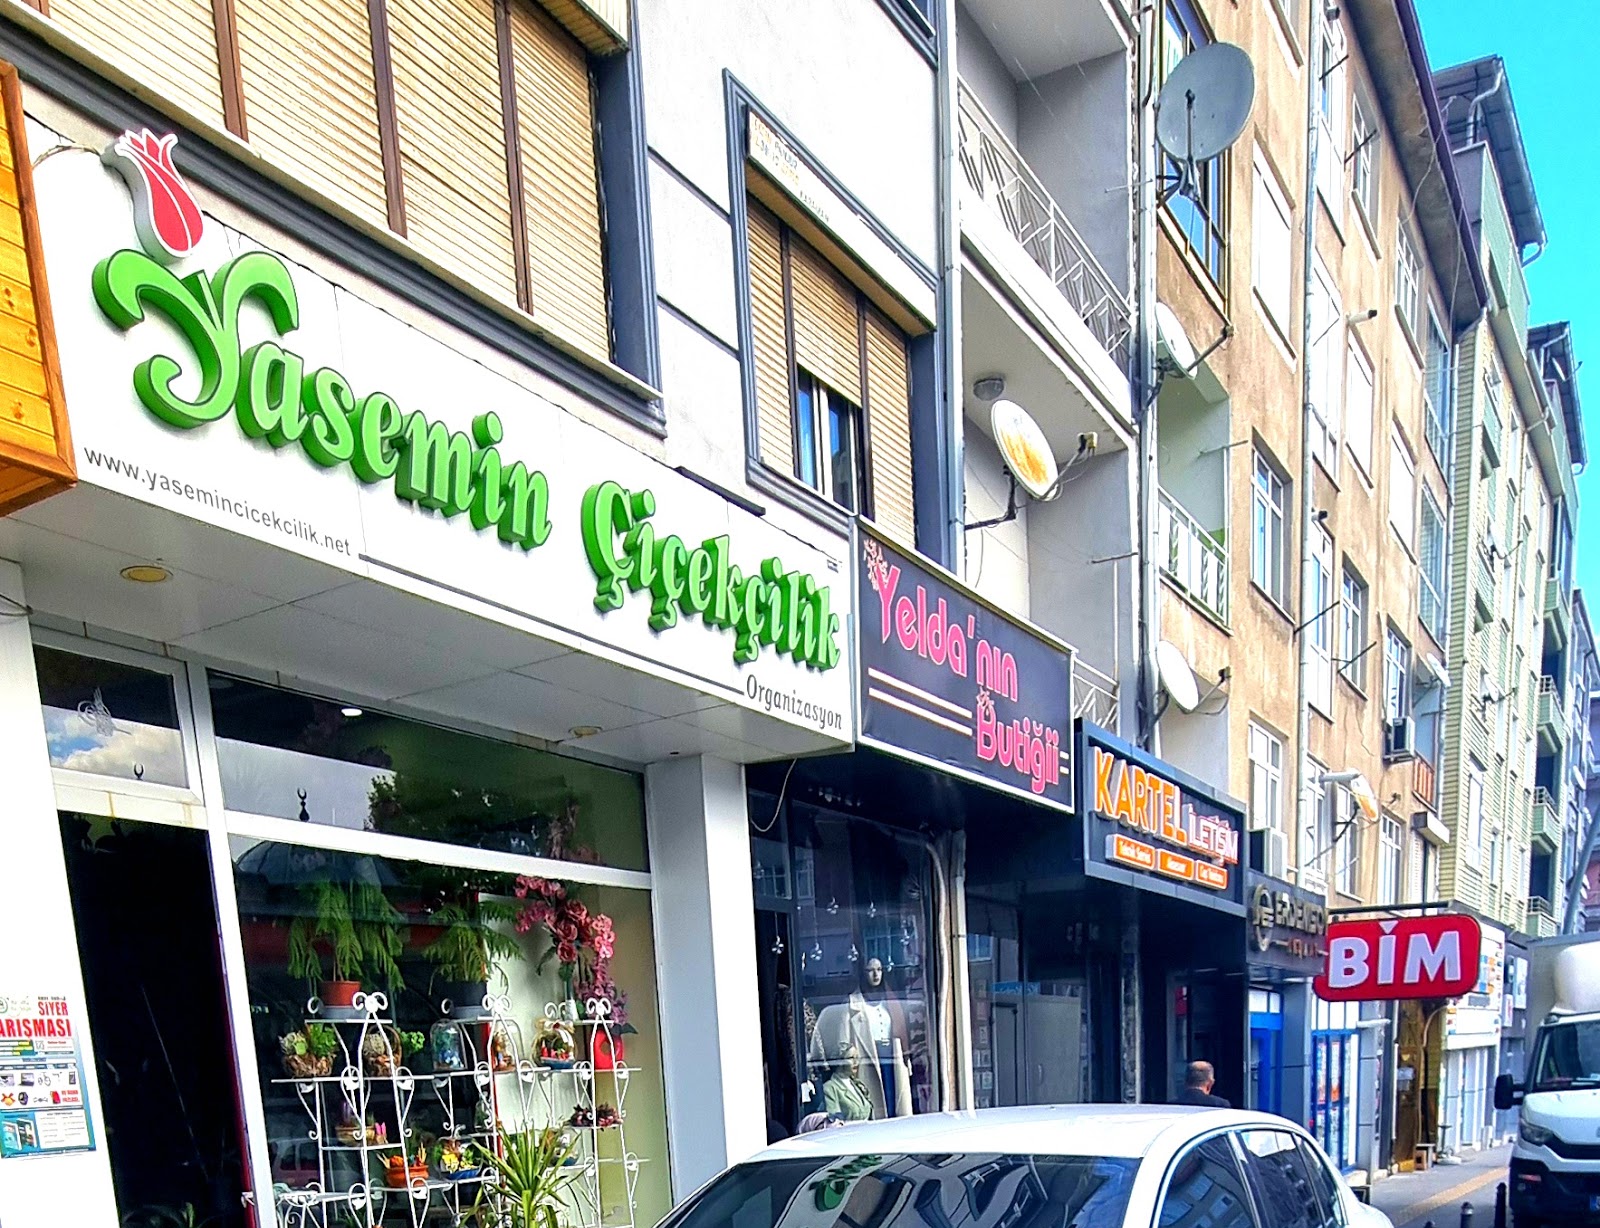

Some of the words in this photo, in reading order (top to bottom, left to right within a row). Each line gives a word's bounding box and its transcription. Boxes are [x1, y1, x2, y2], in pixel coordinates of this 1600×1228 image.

[84, 446, 352, 557] www.yasemincicekcilik.net
[92, 249, 553, 552] Yasemin
[581, 480, 841, 672] Çiçekçilik
[873, 564, 1019, 703] Yelda'nın
[746, 673, 842, 730] Organizasyon
[1093, 746, 1188, 847] KARTEL
[1328, 920, 1462, 989] BİM
